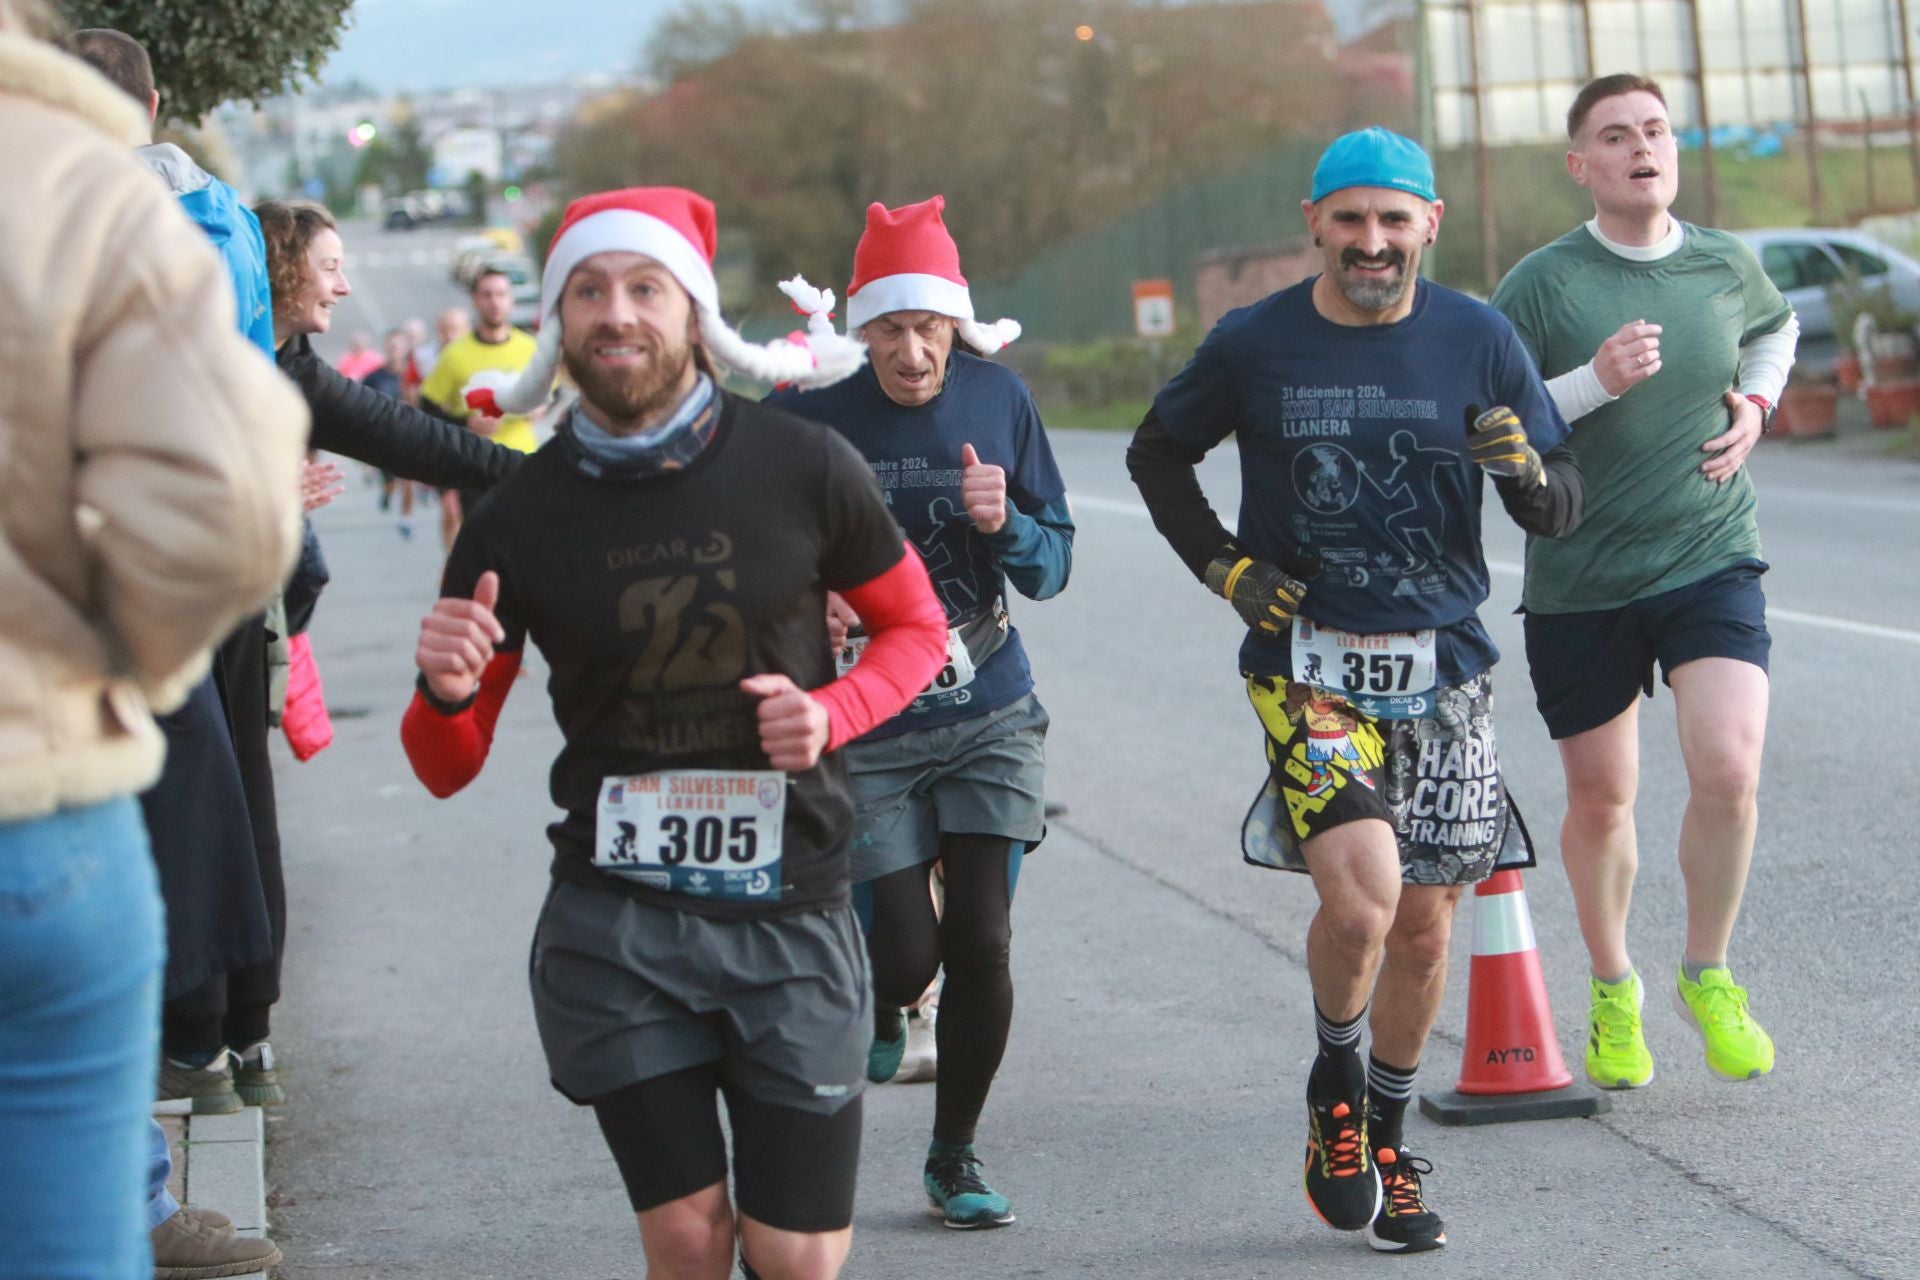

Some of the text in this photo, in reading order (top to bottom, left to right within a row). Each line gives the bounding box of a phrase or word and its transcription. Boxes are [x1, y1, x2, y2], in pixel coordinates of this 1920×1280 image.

[1282, 385, 1386, 399] 31 diciembre 2024
[1282, 400, 1438, 420] XXXI SAN SILVESTRE
[1283, 419, 1351, 437] LLANERA
[902, 457, 928, 470] 2024
[607, 538, 687, 571] DICAR
[1337, 634, 1389, 650] LLANERA
[1342, 652, 1414, 692] 357
[1390, 696, 1413, 705] DICAR
[1417, 736, 1496, 780] HARD
[626, 776, 757, 796] SAN SILVESTRE
[657, 797, 727, 811] LLANERA
[1412, 777, 1497, 821] CORE
[659, 815, 758, 865] 305
[1485, 1048, 1535, 1064] AYTO
